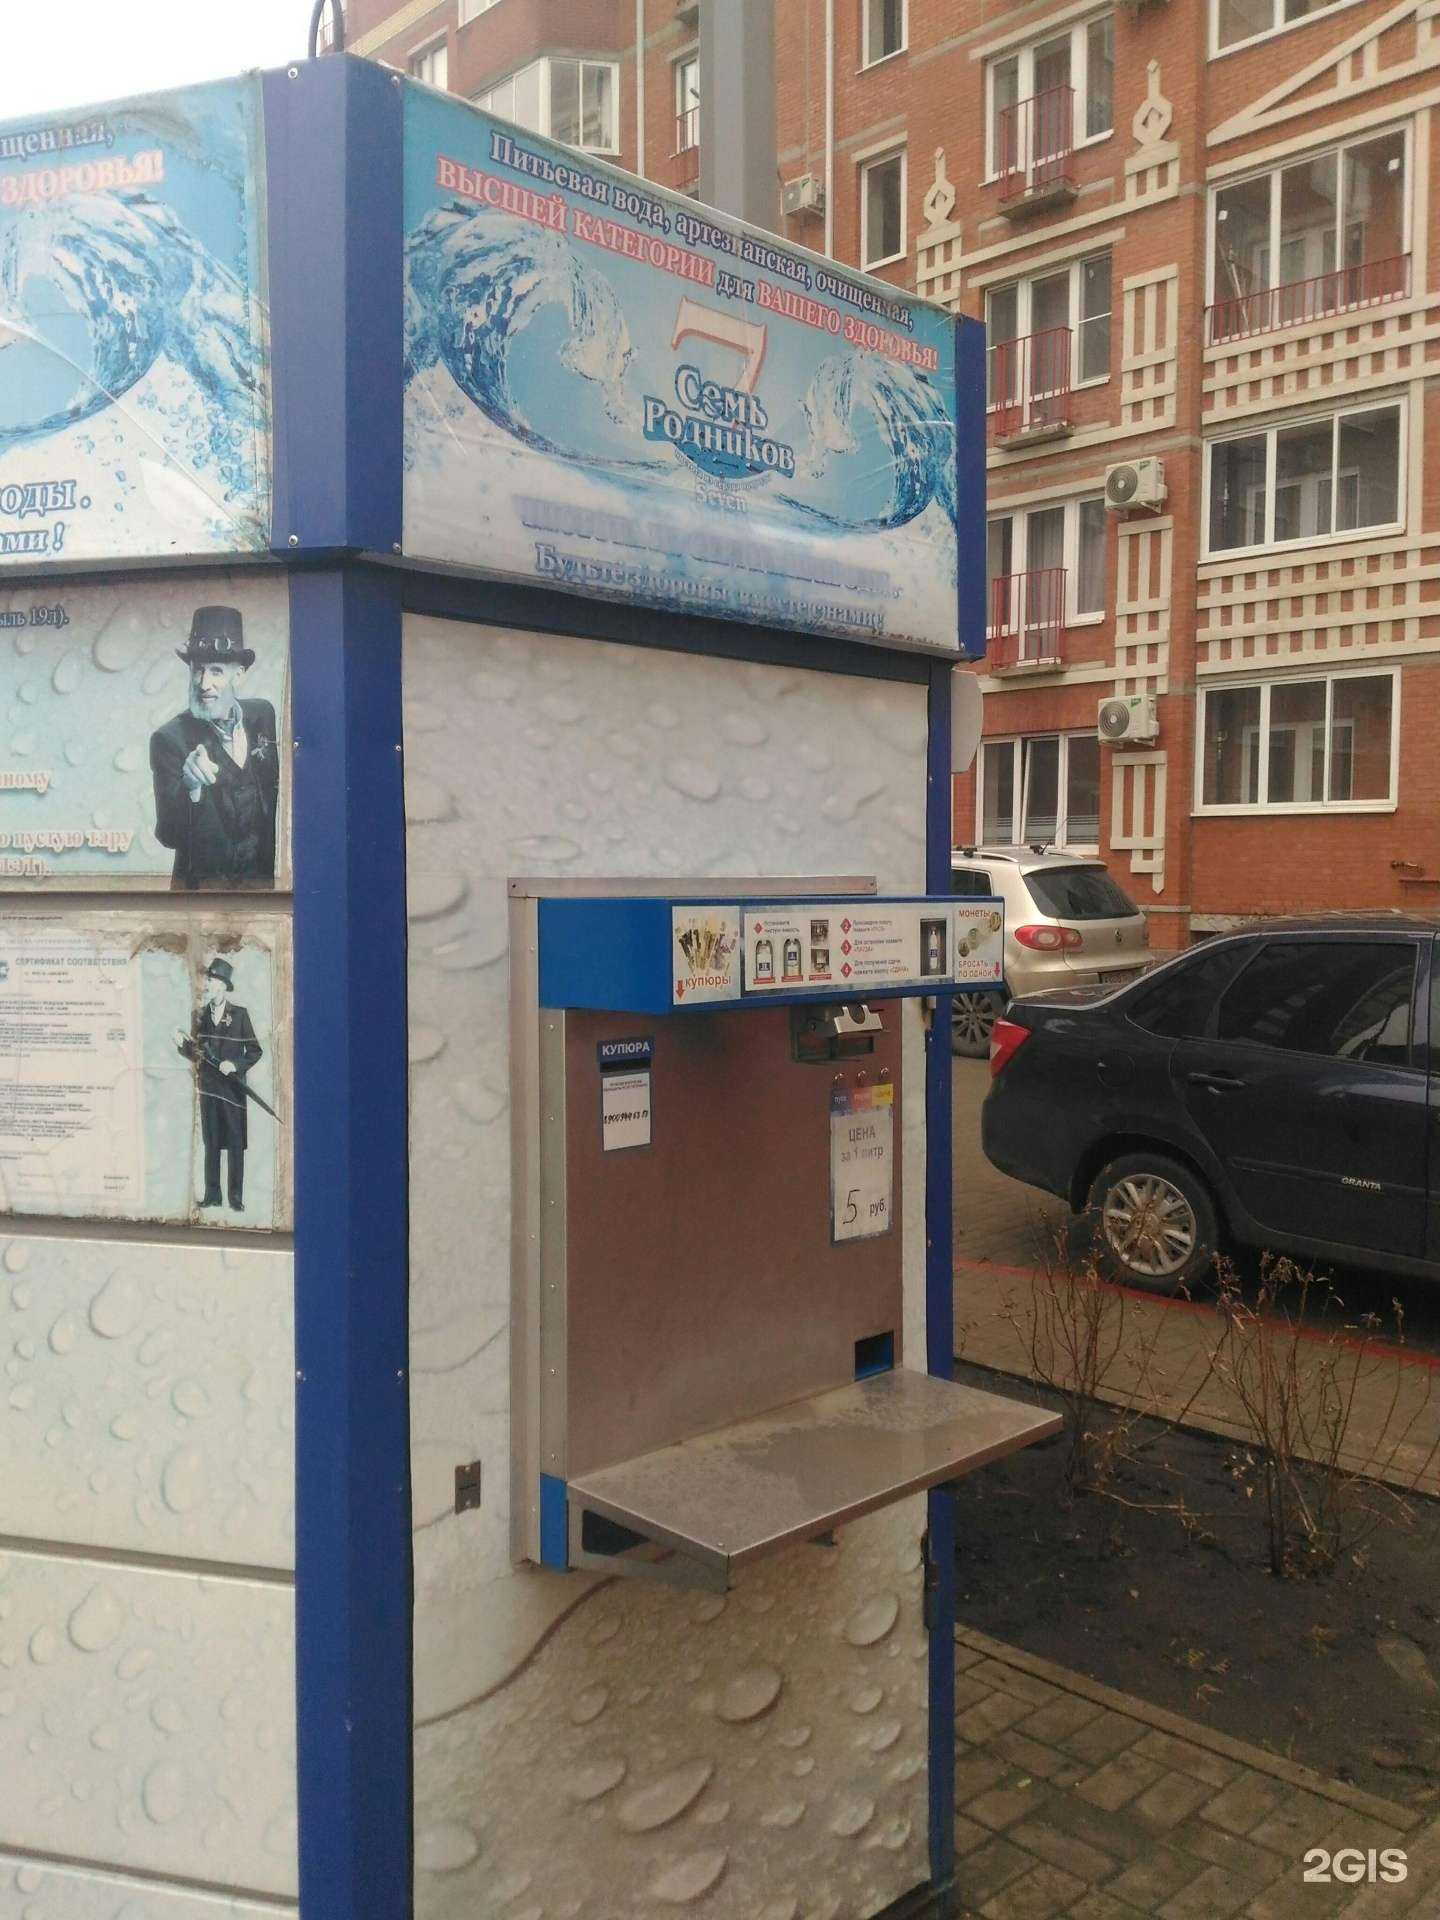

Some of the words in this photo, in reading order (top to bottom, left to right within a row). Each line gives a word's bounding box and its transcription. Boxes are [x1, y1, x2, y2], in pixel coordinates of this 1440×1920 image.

[490, 130, 609, 203] Питьевая
[612, 187, 671, 234] вода,
[436, 154, 568, 234] ВЫСШЕЙ
[573, 208, 716, 288] КАТЕГОРИИ
[716, 271, 754, 304] для
[757, 281, 841, 334] ВАШЕГО
[844, 317, 938, 371] ЗДОРОВЬЯ!
[675, 364, 769, 430] Семь
[643, 396, 796, 473] Родников
[685, 975, 731, 991] купюры
[602, 1041, 651, 1057] КУПЮРА
[848, 1125, 876, 1142] ЦЕНА
[1341, 1177, 1382, 1190] GRANTA
[842, 1189, 861, 1225] 5
[869, 1198, 887, 1218] руб.
